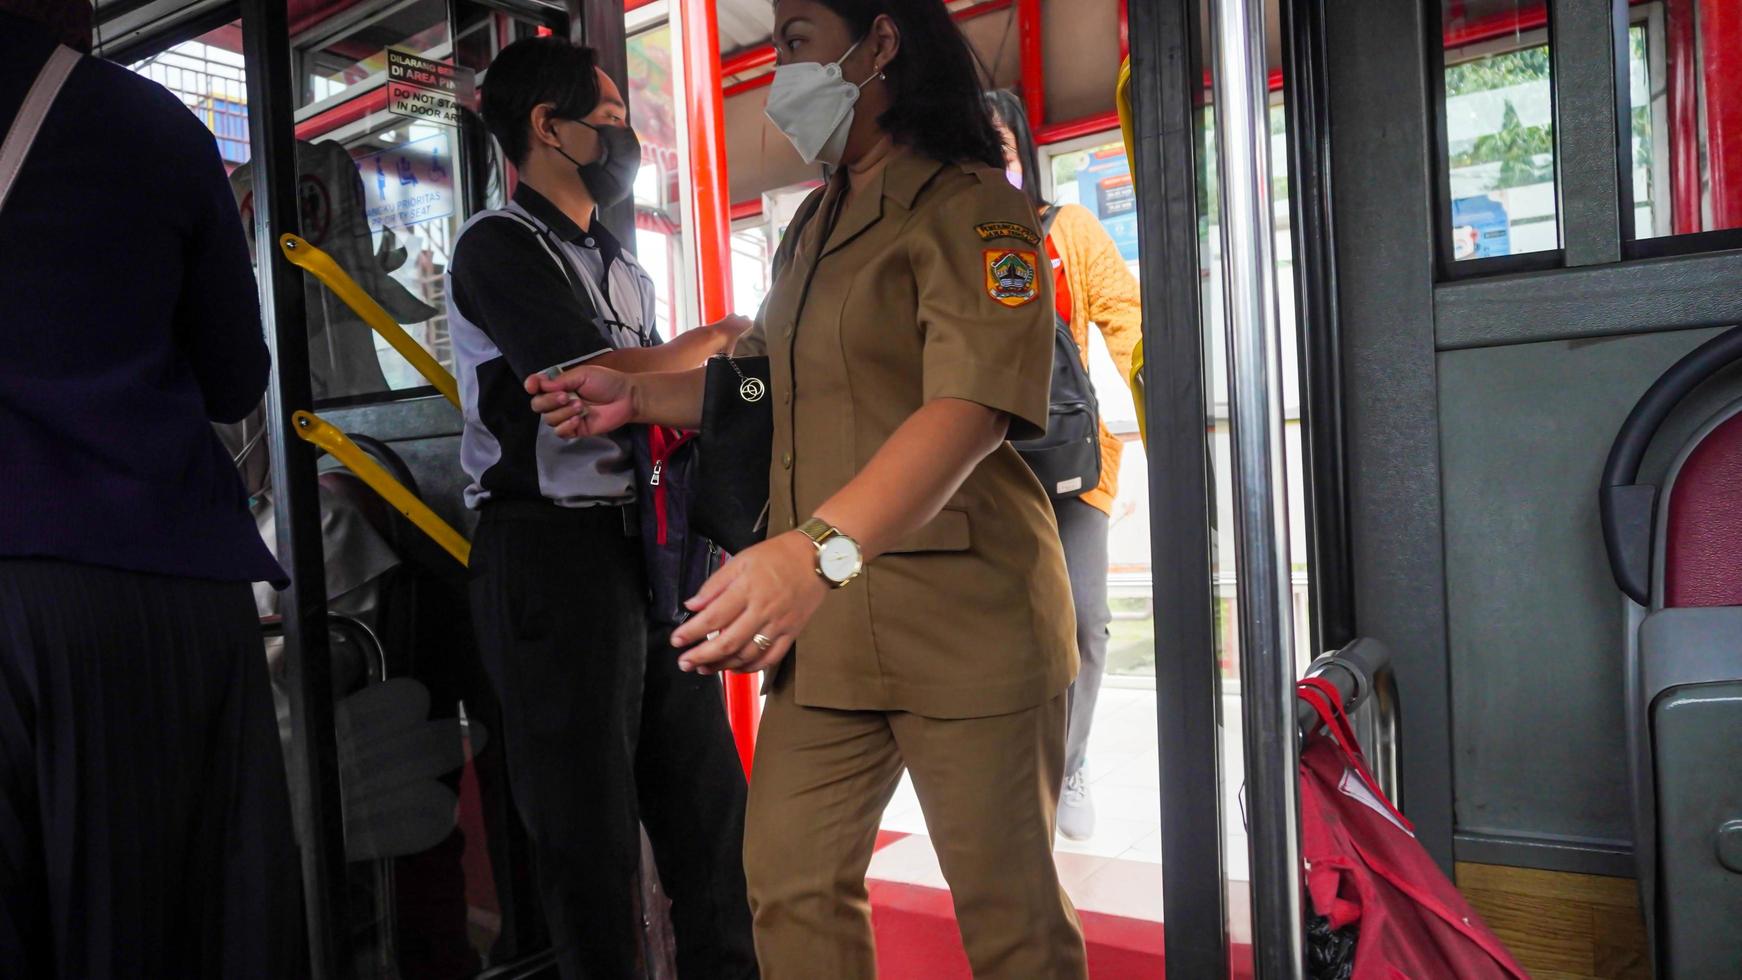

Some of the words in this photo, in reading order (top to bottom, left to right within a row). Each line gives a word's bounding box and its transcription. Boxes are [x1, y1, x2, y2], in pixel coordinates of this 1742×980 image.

[390, 53, 436, 73] DILARANG
[391, 65, 404, 76] DI
[406, 69, 437, 85] AREA
[394, 88, 410, 99] DO
[412, 92, 436, 105] NOT
[437, 98, 458, 110] STA
[397, 101, 408, 111] IN
[410, 104, 441, 118] DOOR
[443, 112, 458, 122] AR
[397, 192, 441, 211] PRIORITAS
[409, 206, 431, 219] SEAT
